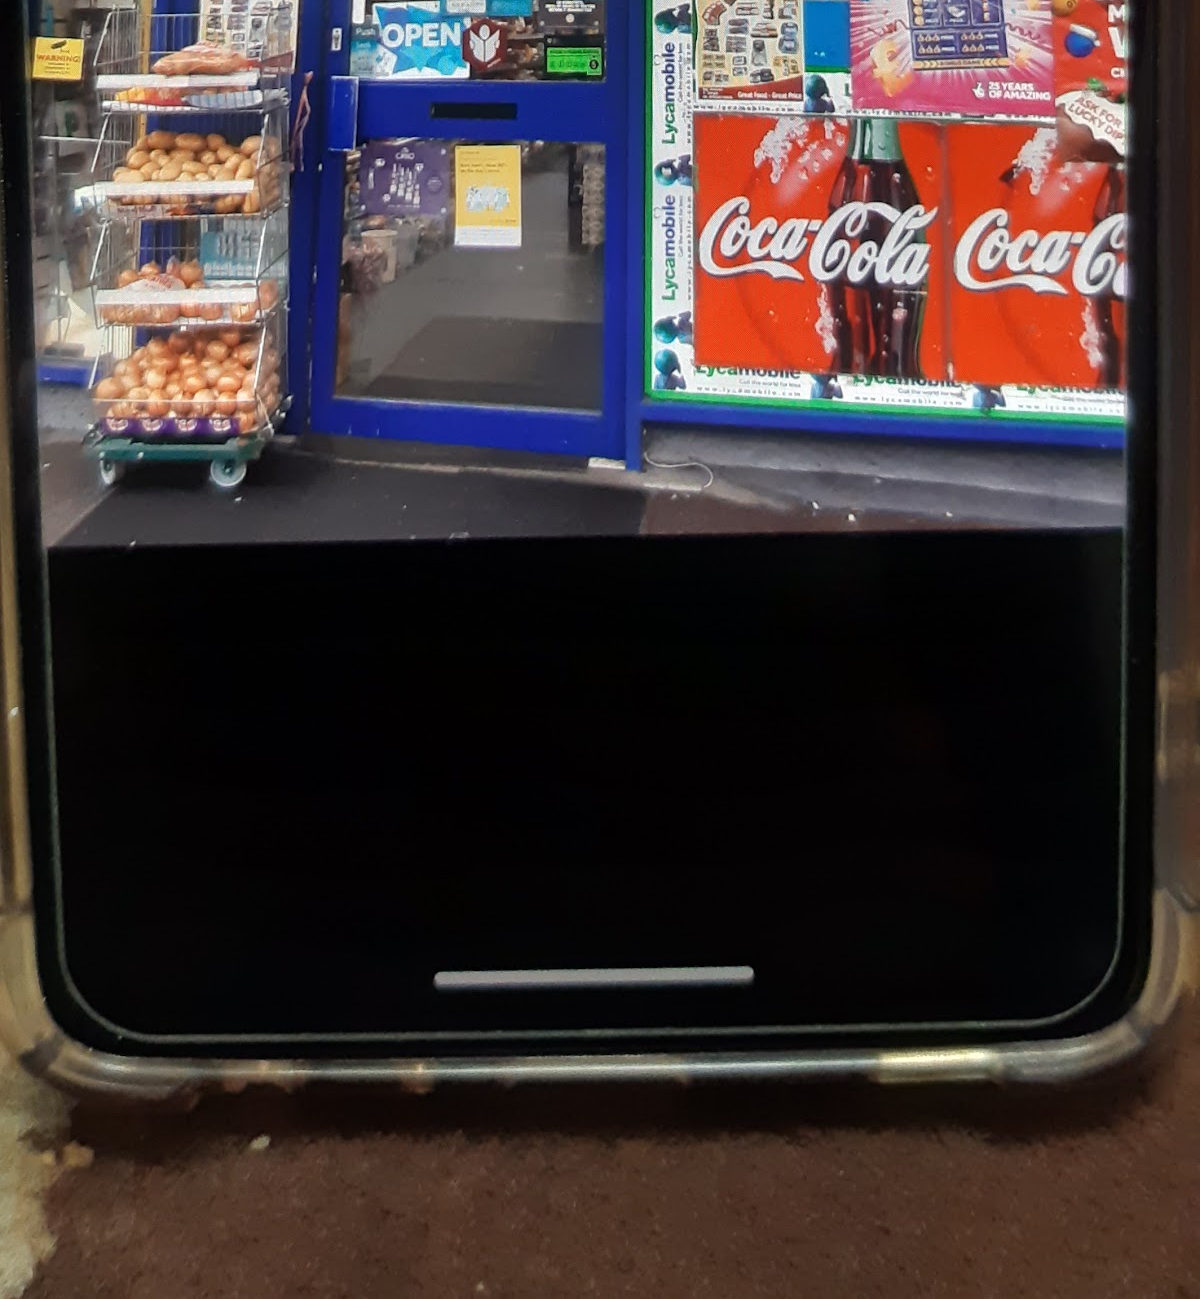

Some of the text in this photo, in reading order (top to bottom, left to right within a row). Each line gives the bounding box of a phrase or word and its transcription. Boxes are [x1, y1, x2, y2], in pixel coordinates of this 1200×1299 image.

[380, 22, 461, 48] OPEN
[662, 42, 678, 144] Lycamobile
[988, 81, 1034, 91] 25 YEARS
[988, 90, 1051, 101] OF AMAZING
[1067, 103, 1105, 129] LUCKY
[1075, 96, 1123, 128] ASK FOR
[662, 195, 678, 301] Lycamobile
[699, 195, 939, 286] Coca-Cola
